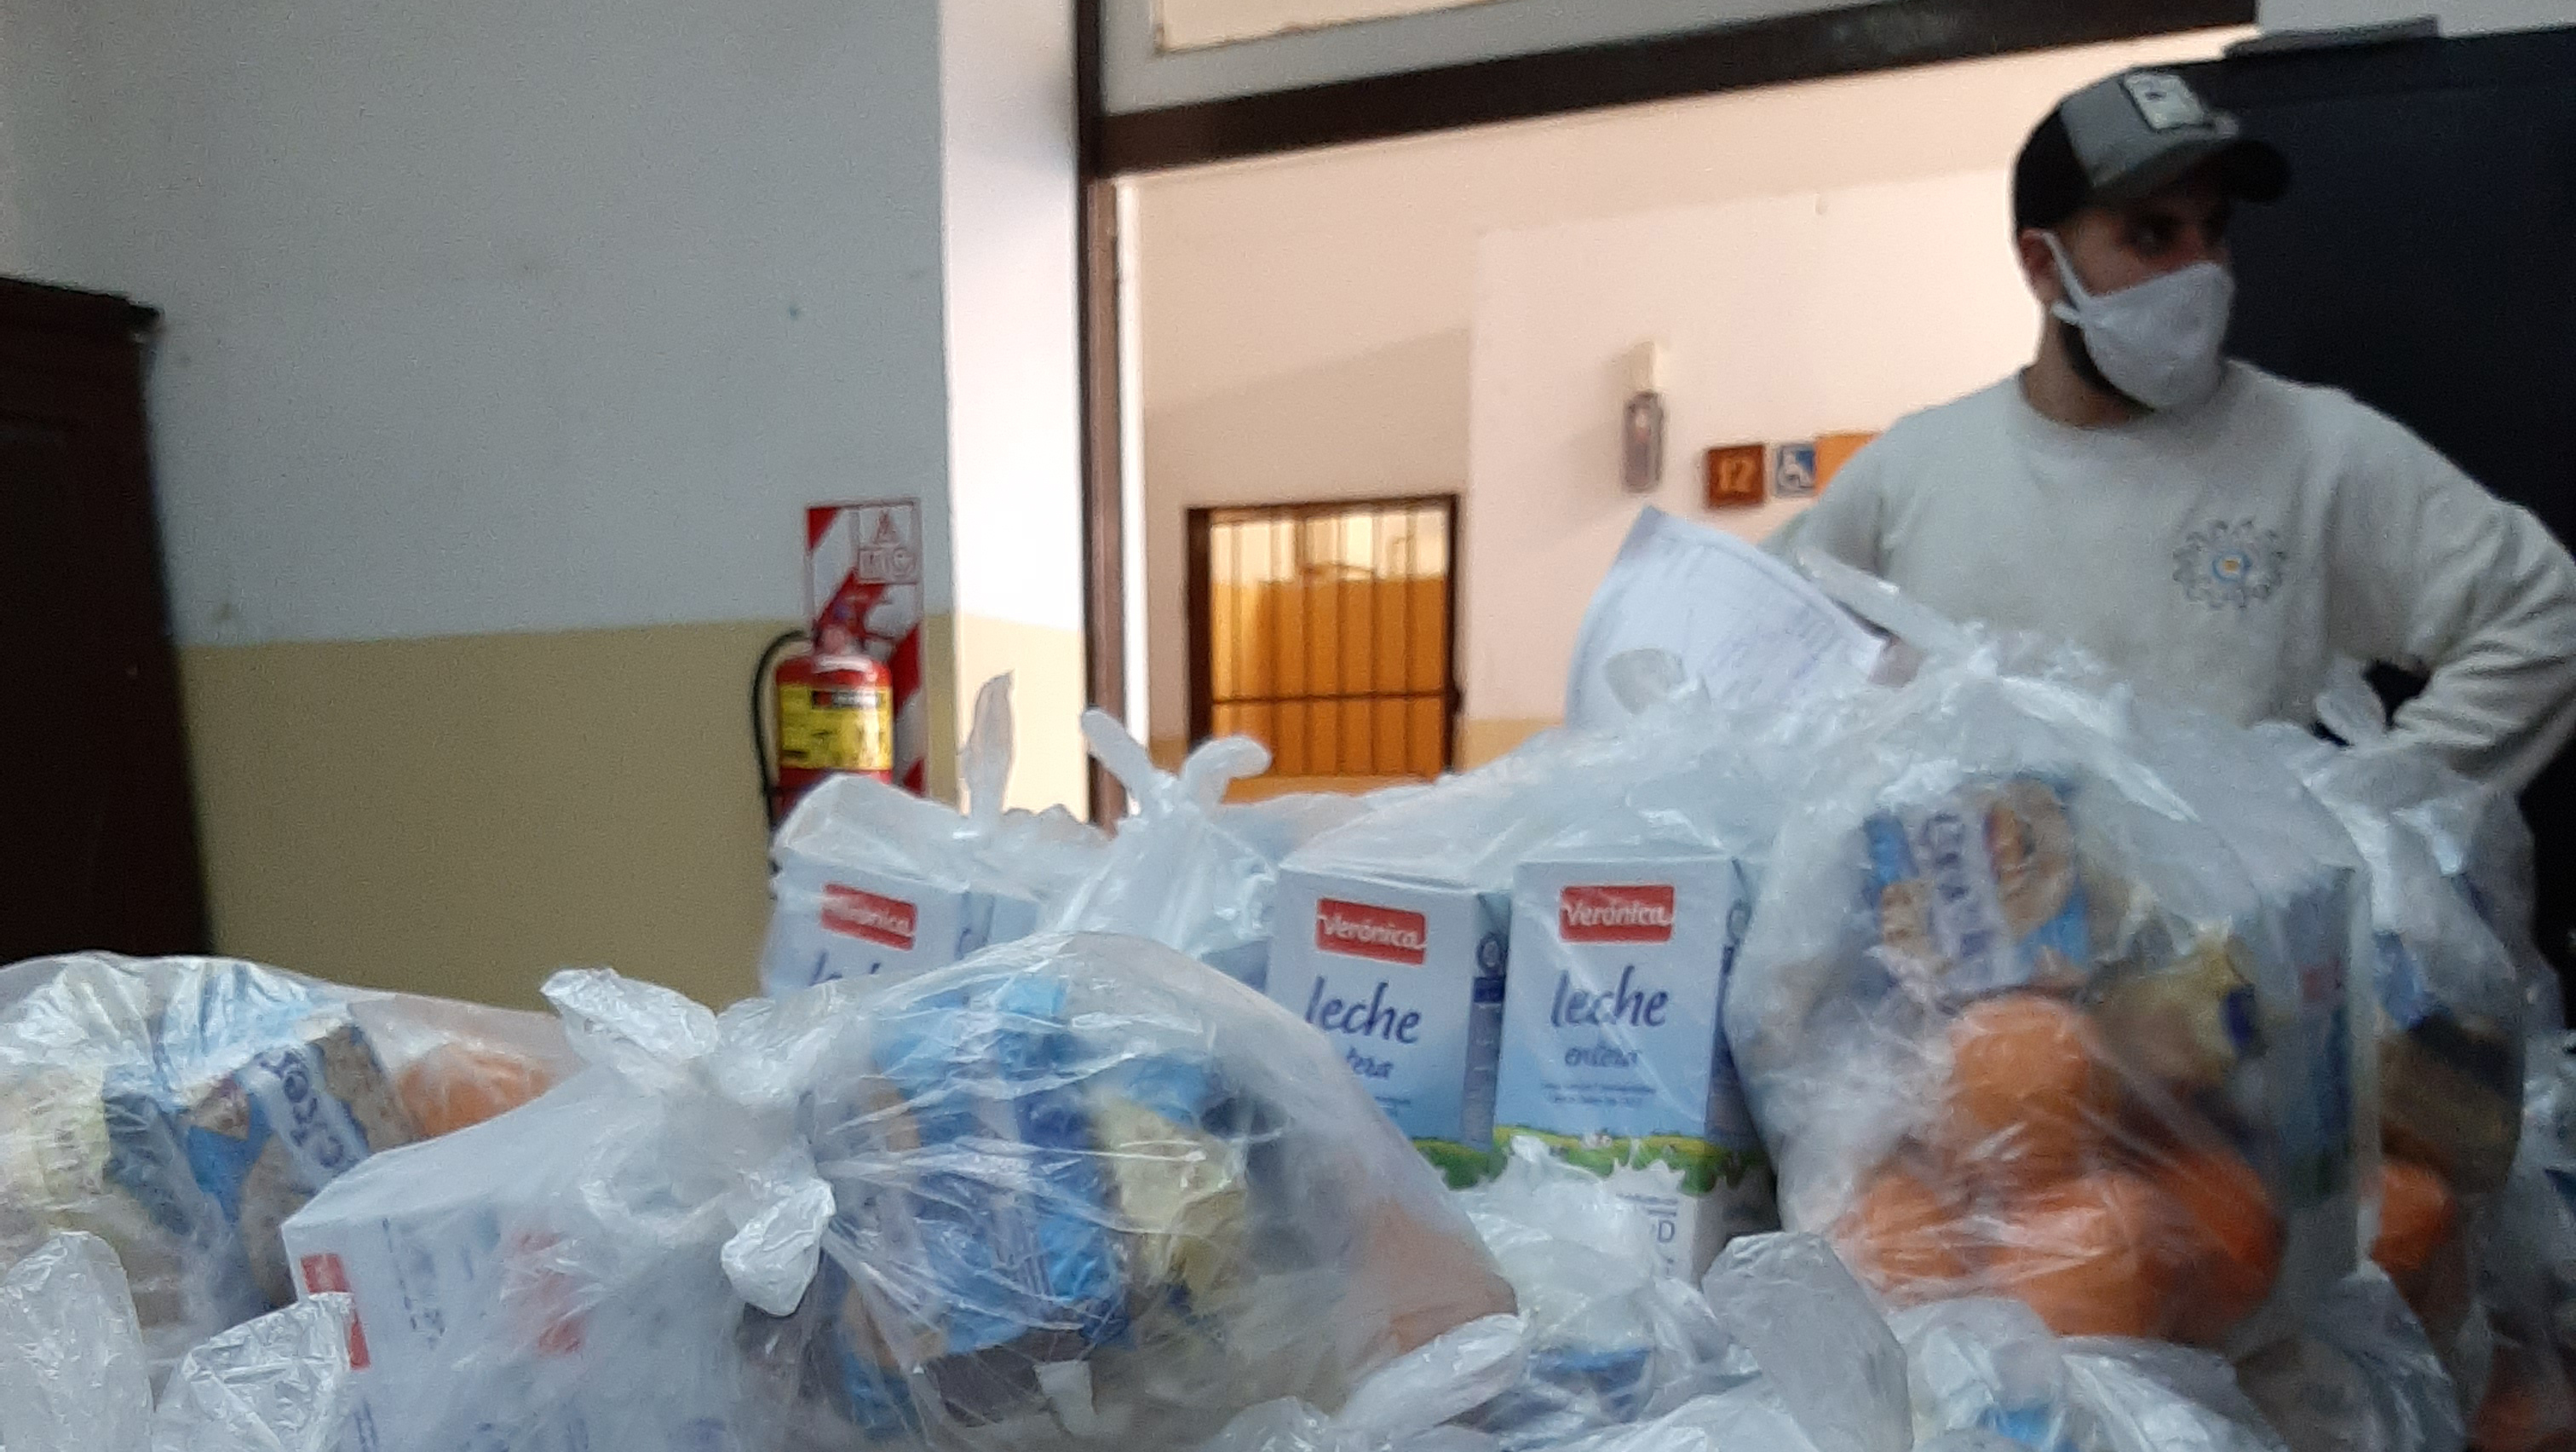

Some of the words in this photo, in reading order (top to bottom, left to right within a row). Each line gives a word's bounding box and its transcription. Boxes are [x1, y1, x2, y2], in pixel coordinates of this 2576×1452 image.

[1316, 913, 1428, 949] Verónica
[1561, 900, 1673, 925] Verónica
[1304, 976, 1421, 1044] leche
[1550, 965, 1669, 1027] leche
